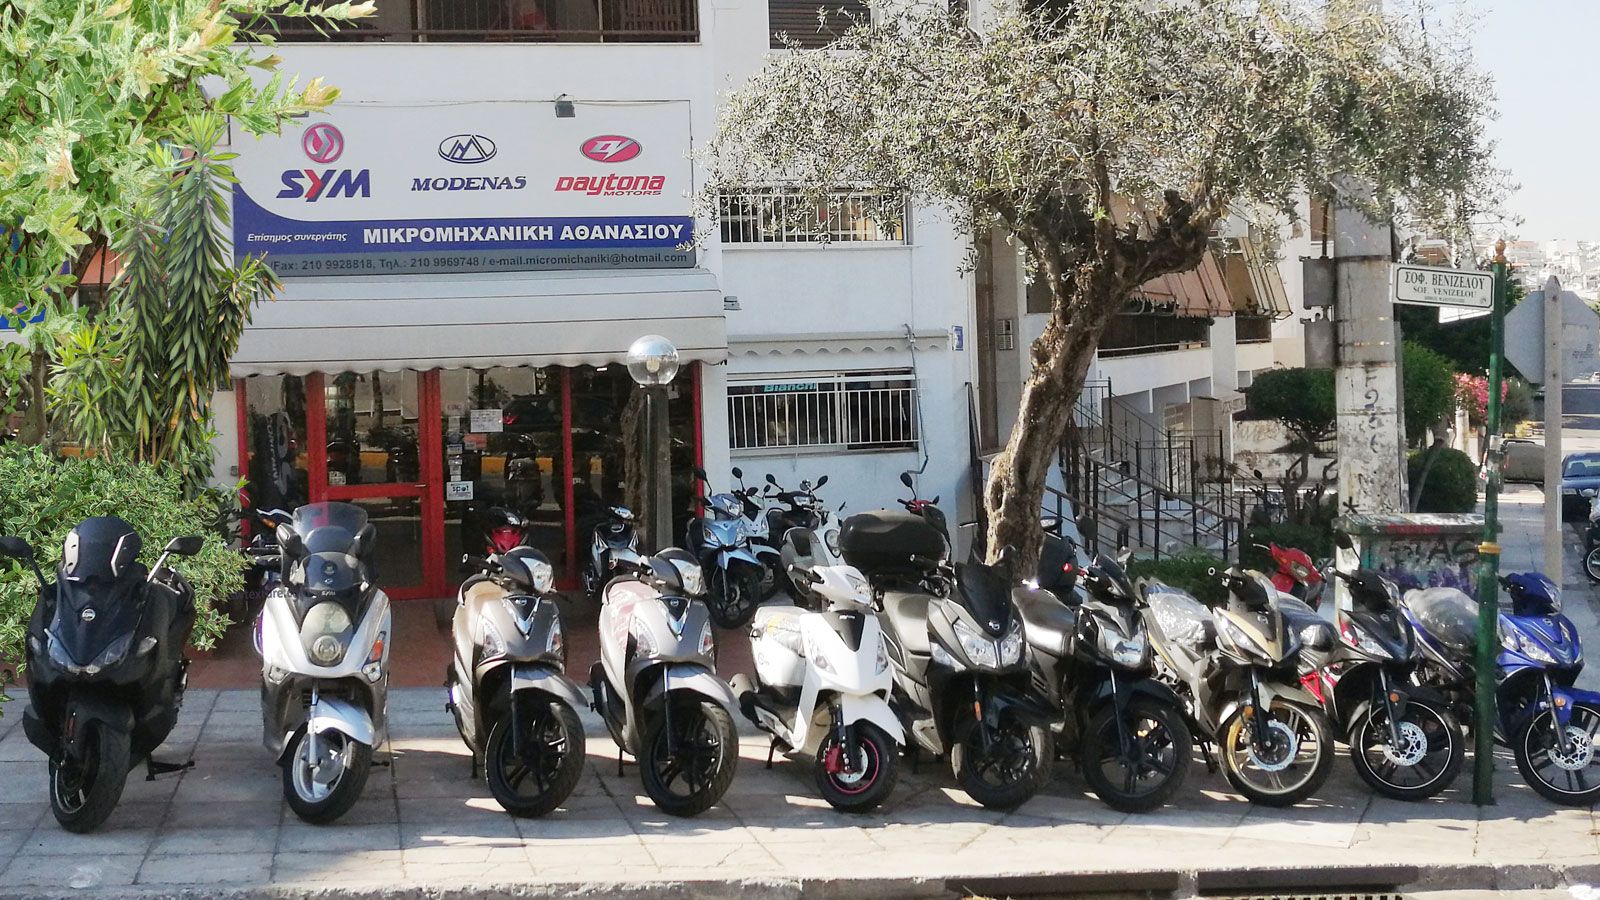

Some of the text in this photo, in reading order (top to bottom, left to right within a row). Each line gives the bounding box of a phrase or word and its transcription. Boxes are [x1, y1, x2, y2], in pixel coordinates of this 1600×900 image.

[276, 169, 370, 202] SYM
[411, 175, 527, 191] MODENAS
[555, 173, 665, 195] Daytona
[247, 232, 348, 243] Επίσημος συνεργάτης
[363, 224, 684, 244] ΜΙΚΡΟΜΗΧΑΝΙΚΗ ΑΘΑΝΑΣΙΟΥ
[302, 260, 322, 270] 210
[411, 258, 430, 268] 210
[433, 256, 479, 267] 9969748
[1432, 273, 1485, 290] ΒΕΝΙΖΕΛΟΥ
[1433, 287, 1477, 298] VENIZELOU
